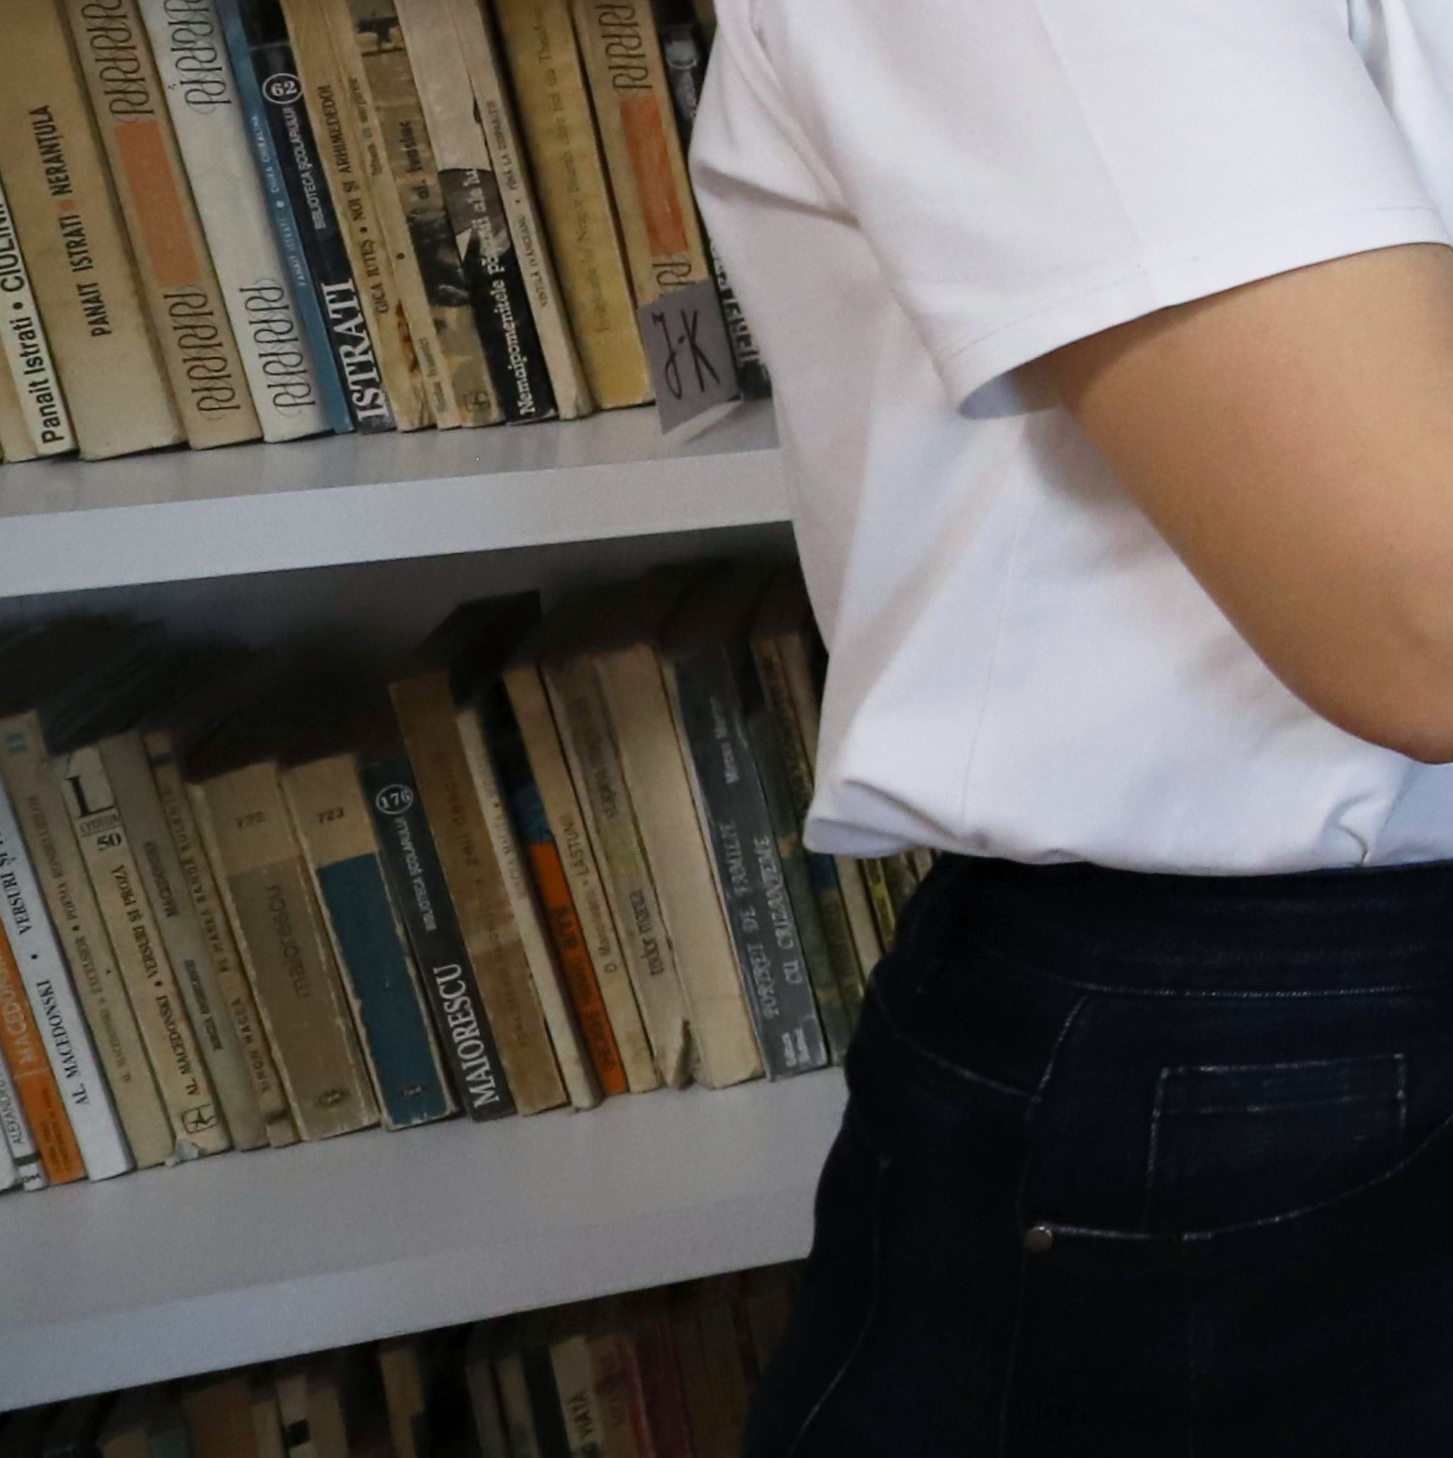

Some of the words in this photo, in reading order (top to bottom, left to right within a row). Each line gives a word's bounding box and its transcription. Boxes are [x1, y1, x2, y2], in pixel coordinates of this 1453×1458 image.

[271, 79, 298, 96] 62
[30, 104, 74, 197] NERANȚULA
[299, 171, 325, 230] BIBLIOTECA
[62, 212, 96, 274] ISTRATI
[78, 282, 112, 338] PANAIT
[17, 315, 50, 375] Istrati
[321, 278, 388, 422] ISTRATI
[493, 278, 537, 416] Nemaipomenitele
[29, 379, 64, 446] Panait
[7, 871, 33, 935] VERSURI
[37, 979, 80, 1080] MACEDONSKI
[156, 994, 191, 1075] MACEDONSKI
[434, 963, 500, 1110] MAIORESCU
